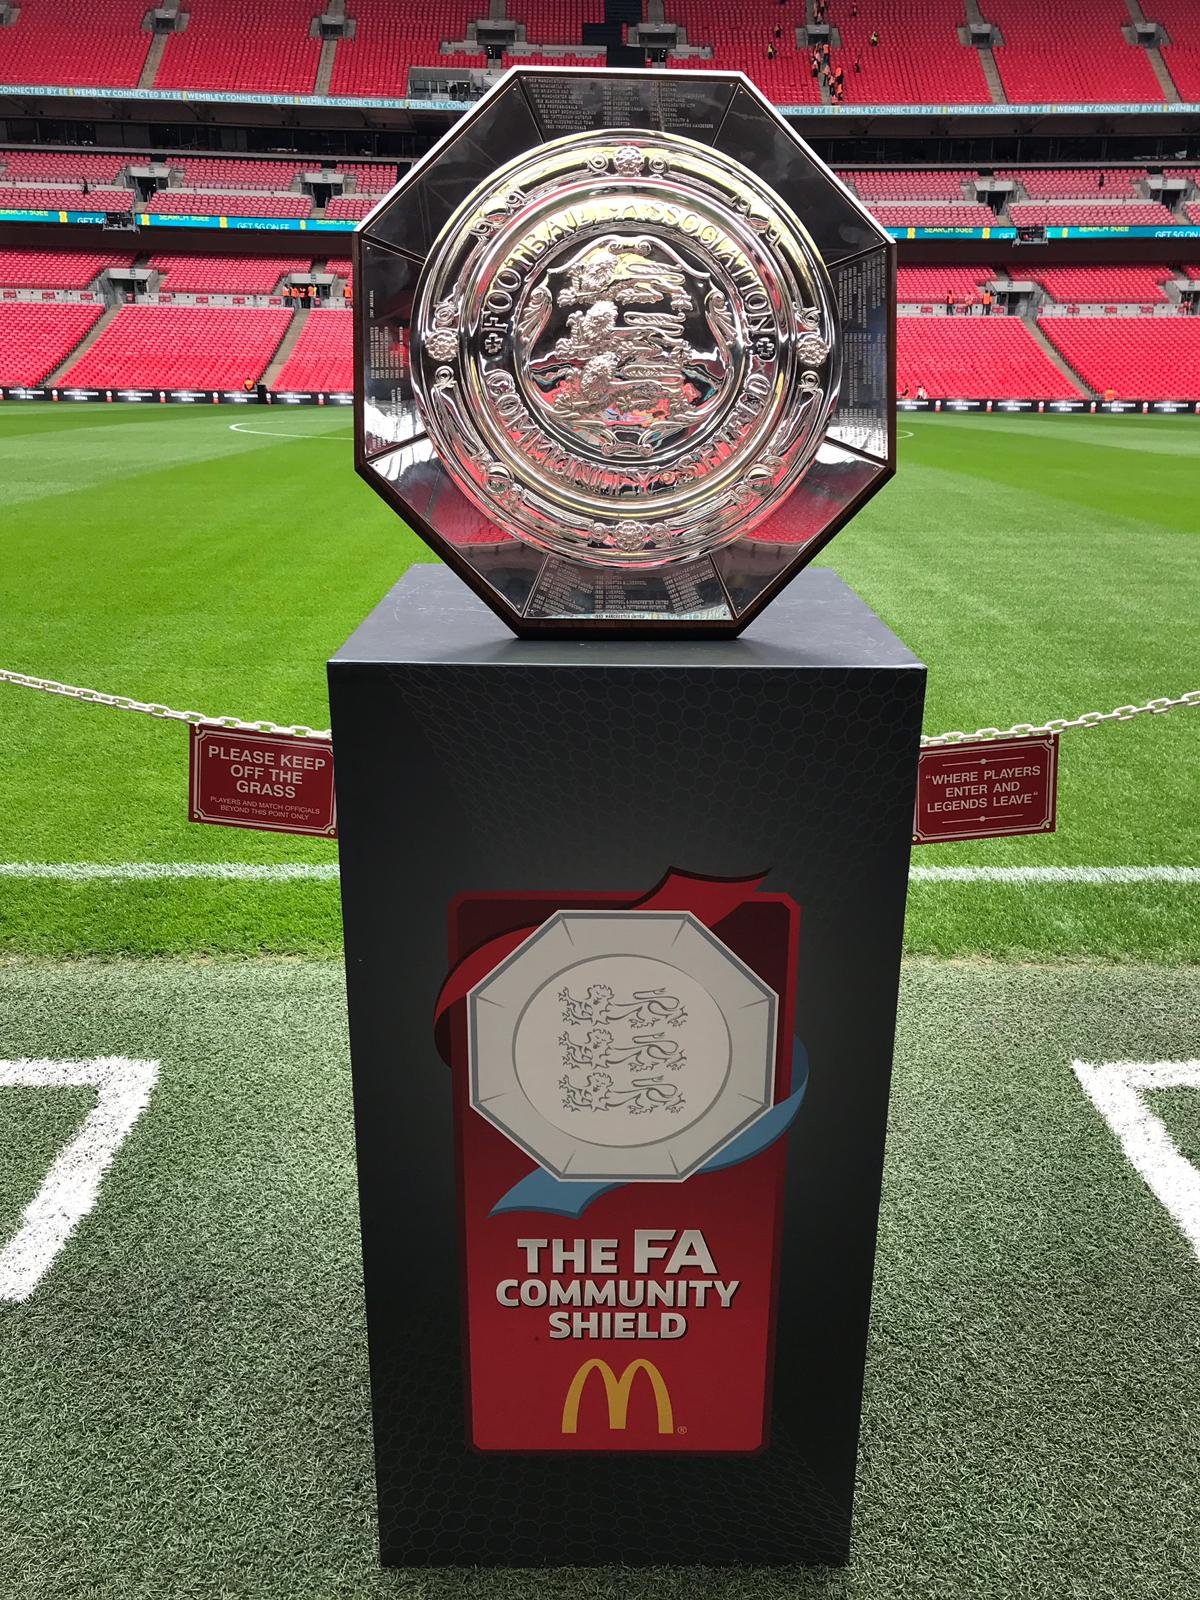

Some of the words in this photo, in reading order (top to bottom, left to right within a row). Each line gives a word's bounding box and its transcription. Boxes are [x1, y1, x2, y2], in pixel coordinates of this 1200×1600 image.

[74, 88, 112, 96] WEMBLEY
[112, 89, 159, 98] CONNECTED
[187, 92, 225, 100] WEMBLEY
[226, 94, 271, 102] CONNECTED
[300, 97, 336, 106] WEMBLEY
[336, 98, 382, 107] CONNECTED
[410, 100, 446, 109] WEMBLEY
[840, 106, 875, 114] WEMBLEY
[481, 205, 609, 332] FOOTBALL
[622, 203, 776, 336] ASSOCIATION
[486, 369, 652, 495] COMMUNITY
[675, 374, 771, 481] SHIELD
[208, 746, 275, 765] PLEASE
[280, 754, 326, 770] KEEP
[230, 764, 264, 780] OFF
[269, 768, 302, 784] THE
[984, 766, 1041, 780] PLAYERS
[236, 780, 296, 798] GRASS
[946, 784, 988, 798] ENTER
[993, 782, 1020, 794] AND
[210, 796, 240, 806] PLAYERS
[242, 800, 258, 808] AND
[259, 802, 284, 811] MATCH
[285, 805, 320, 814] OFFICIALS
[220, 804, 249, 814] BEYOND
[268, 810, 289, 818] POINT
[291, 812, 310, 820] ONLY
[927, 798, 987, 813] LEGENDS
[517, 1238, 618, 1274] THE
[634, 1229, 718, 1274] FA
[495, 1278, 740, 1308] COMMUNITY
[548, 1312, 687, 1338] SHIELD
